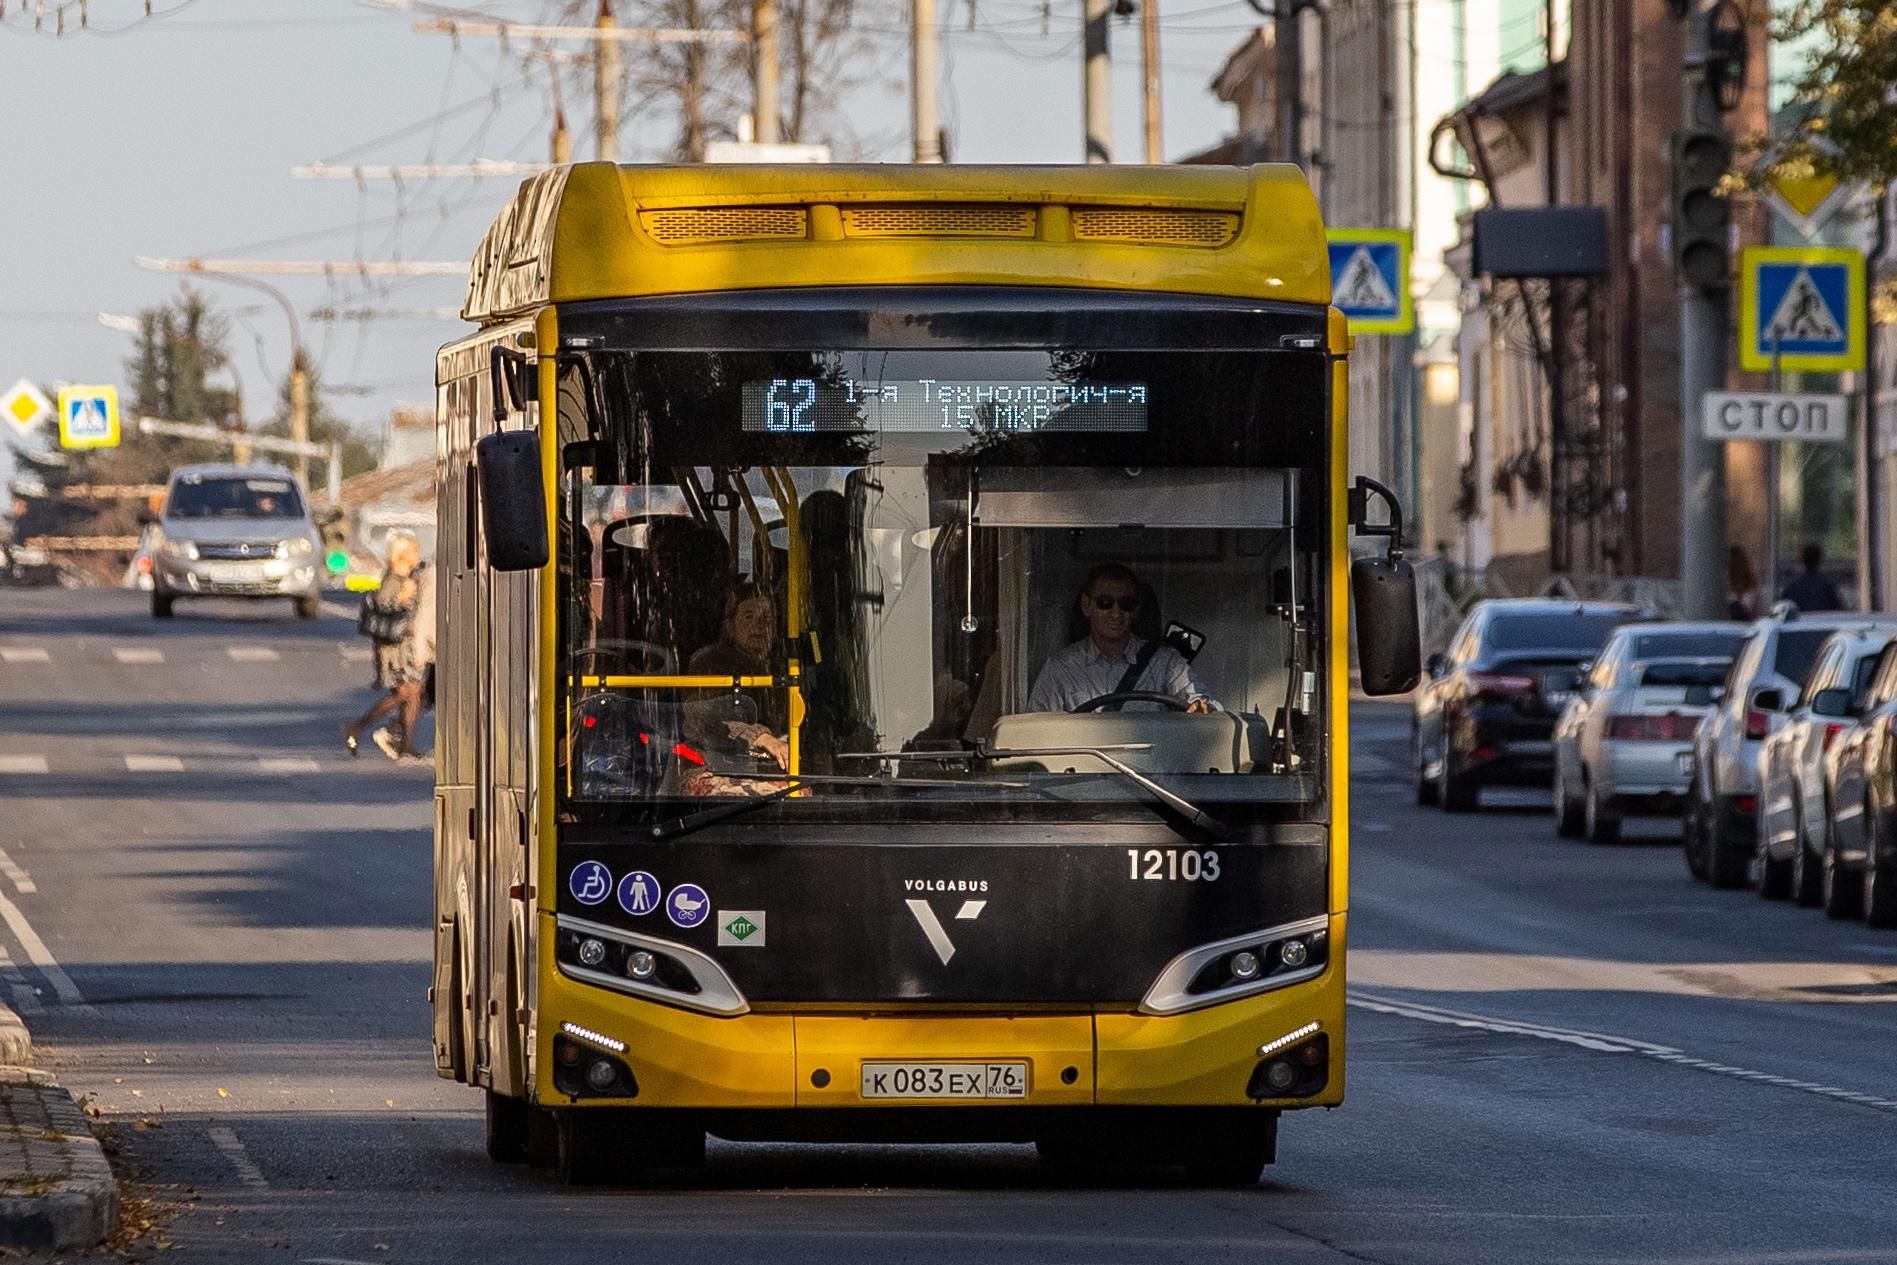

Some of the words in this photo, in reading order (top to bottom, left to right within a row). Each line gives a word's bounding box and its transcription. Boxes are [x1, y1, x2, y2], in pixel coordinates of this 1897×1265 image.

[846, 379, 898, 403] 1-я
[919, 379, 1146, 403] Технологич-я
[767, 379, 816, 432] 62
[941, 405, 973, 428] 15
[1720, 401, 1828, 431] СТОП
[1128, 849, 1221, 881] 12103
[904, 879, 989, 892] VOLGABUS
[731, 922, 752, 934] КПГ
[990, 1067, 1016, 1087] 76
[988, 1087, 1008, 1095] RUS
